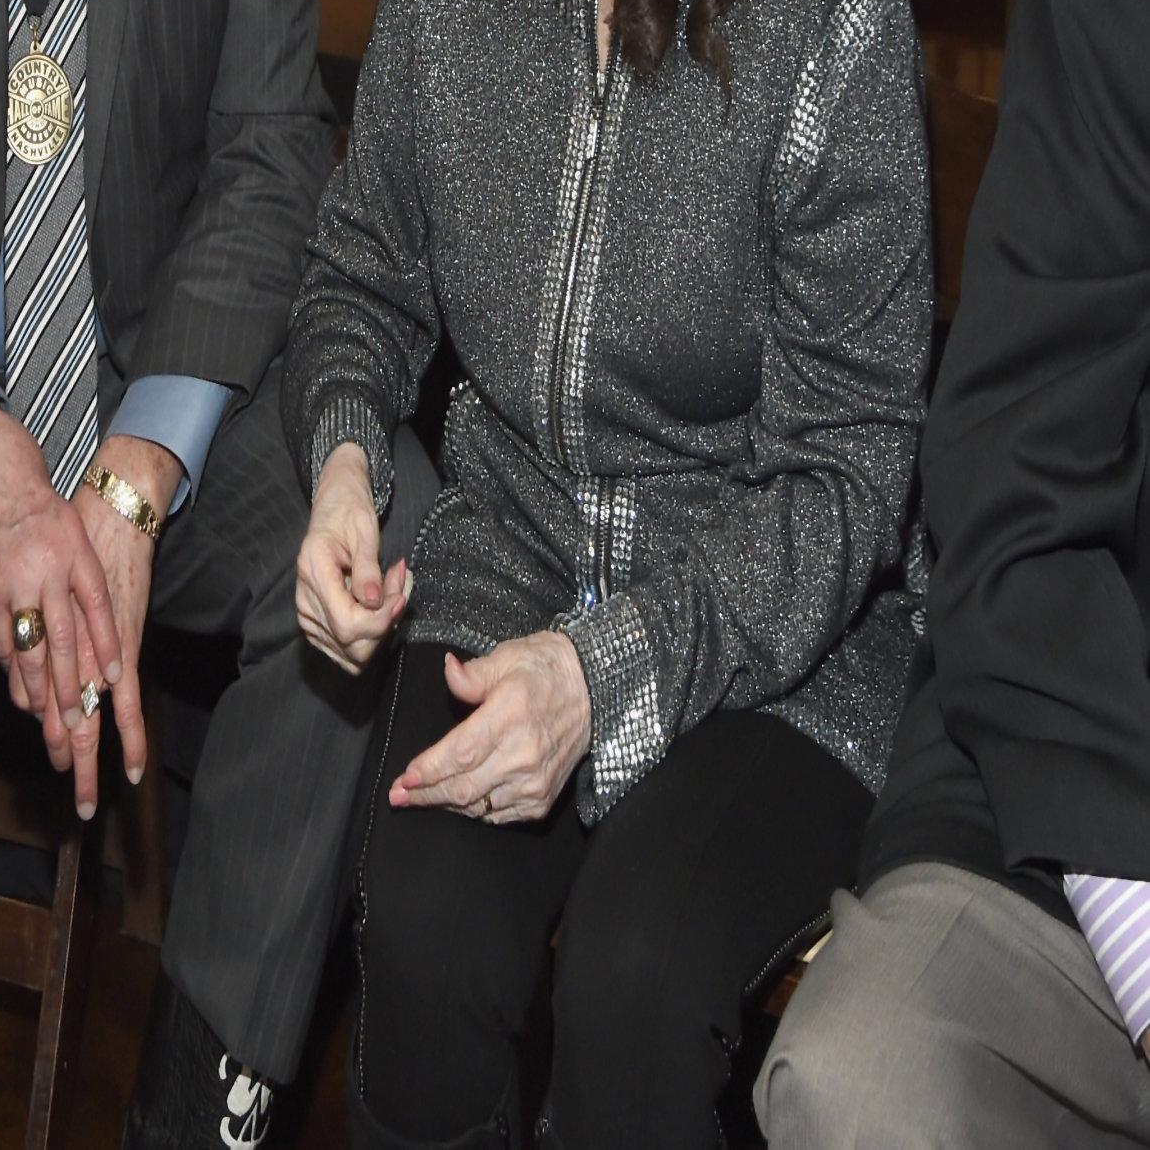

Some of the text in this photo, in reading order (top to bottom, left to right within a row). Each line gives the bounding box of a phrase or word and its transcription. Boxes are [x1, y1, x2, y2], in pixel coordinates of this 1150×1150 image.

[10, 61, 64, 89] COUNTRY
[19, 77, 55, 96] MUSIC
[8, 92, 70, 125] HALL OF FAME
[12, 129, 64, 157] NASHVILLE
